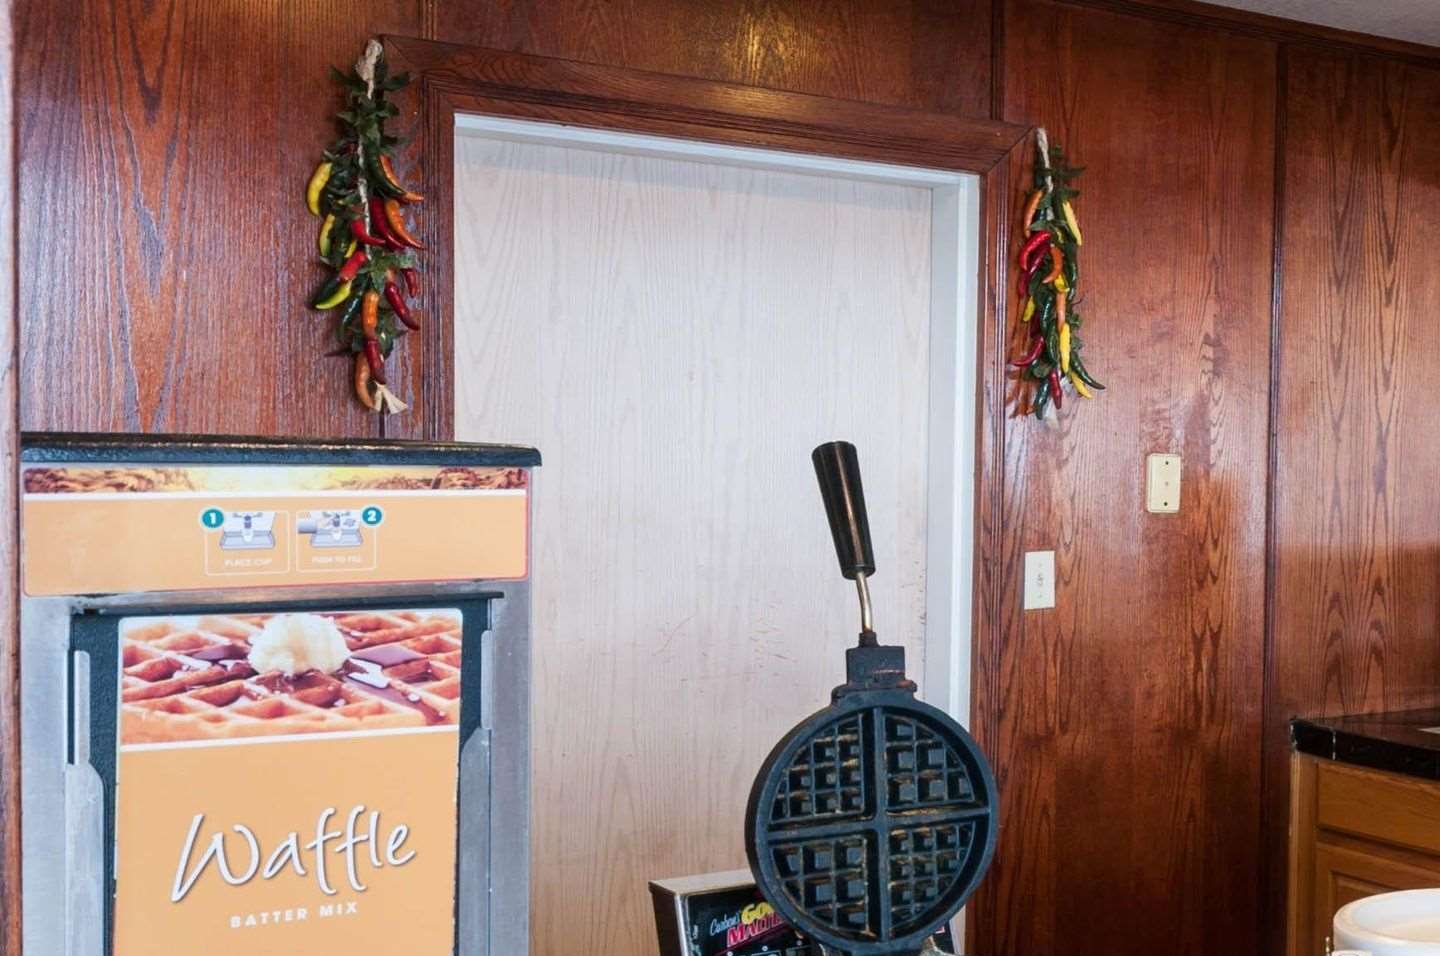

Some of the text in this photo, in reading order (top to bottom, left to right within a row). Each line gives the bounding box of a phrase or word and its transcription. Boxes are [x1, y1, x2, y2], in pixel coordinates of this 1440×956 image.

[170, 804, 417, 904] Waffle
[229, 901, 359, 929] BATTER MIX
